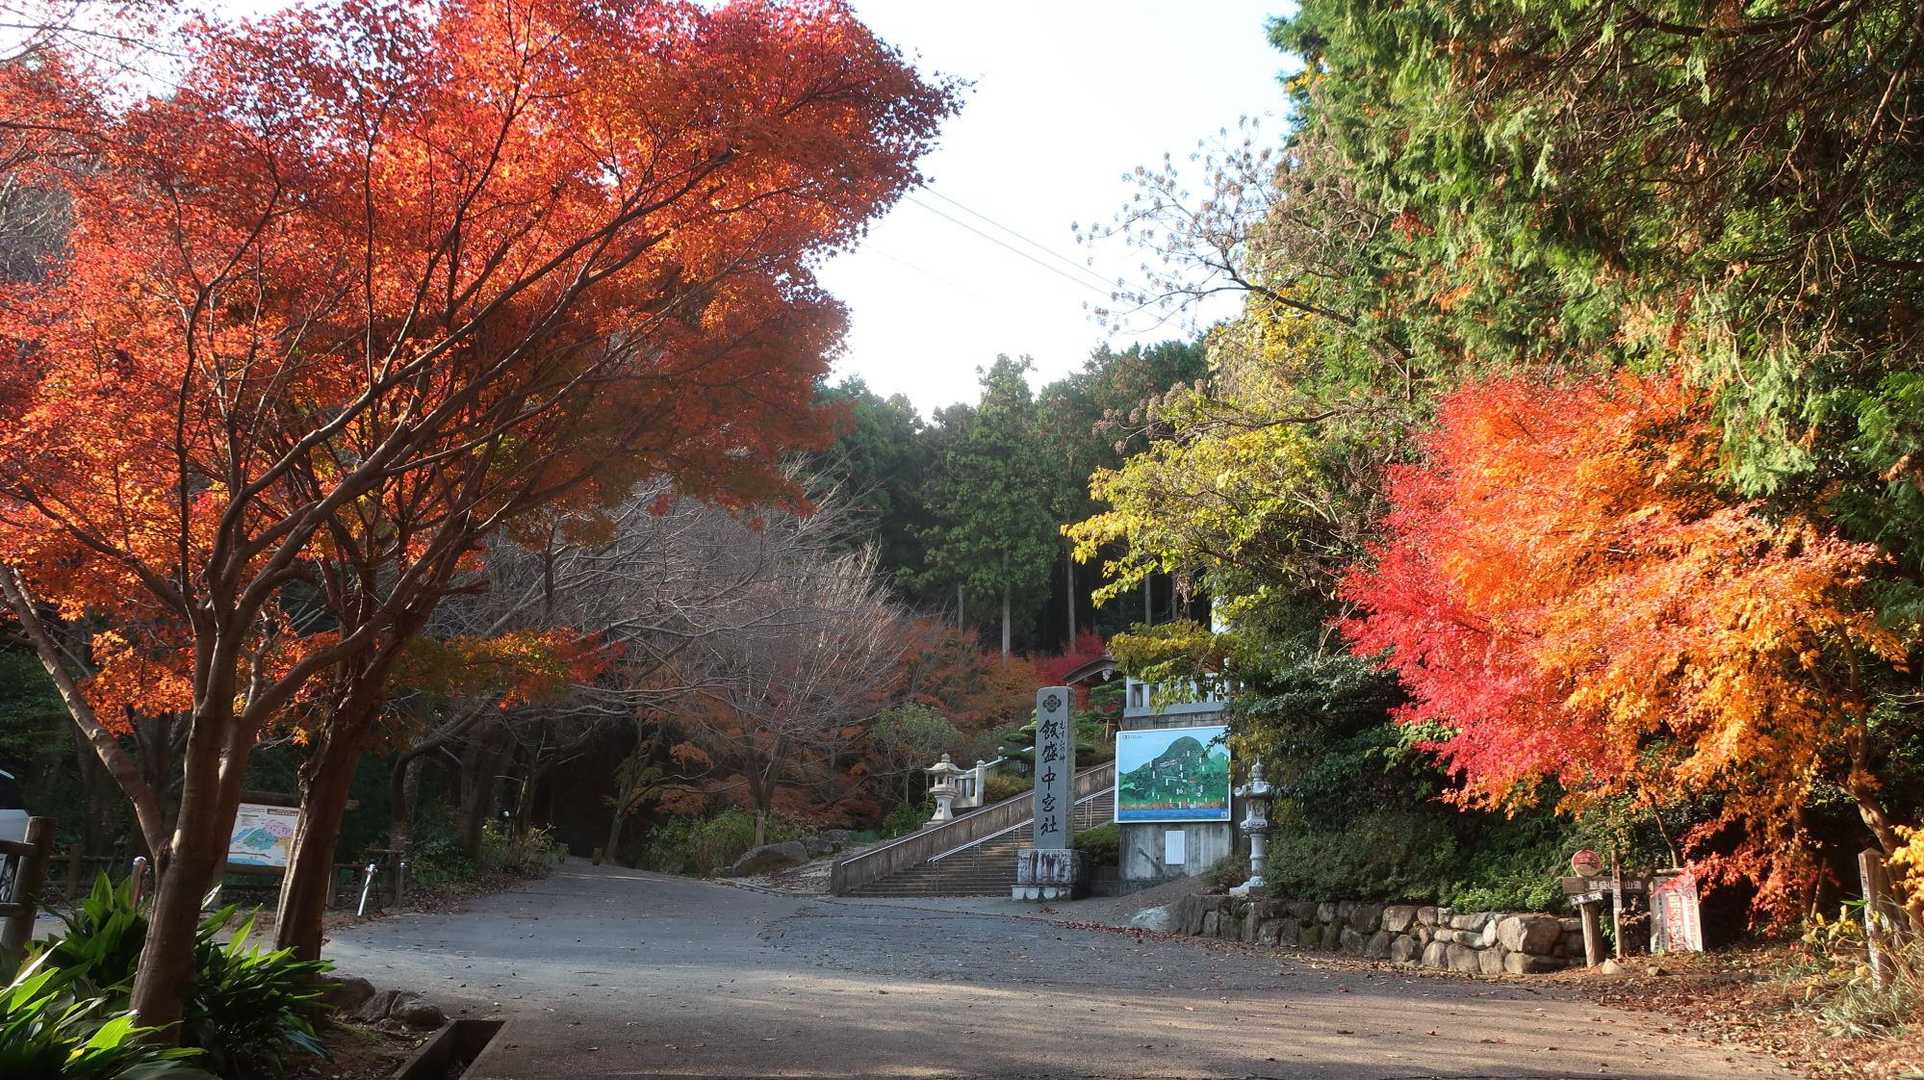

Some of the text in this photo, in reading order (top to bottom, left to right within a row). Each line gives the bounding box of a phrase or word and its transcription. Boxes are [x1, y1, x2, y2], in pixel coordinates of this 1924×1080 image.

[1039, 719, 1058, 836] 飯盛中宮社
